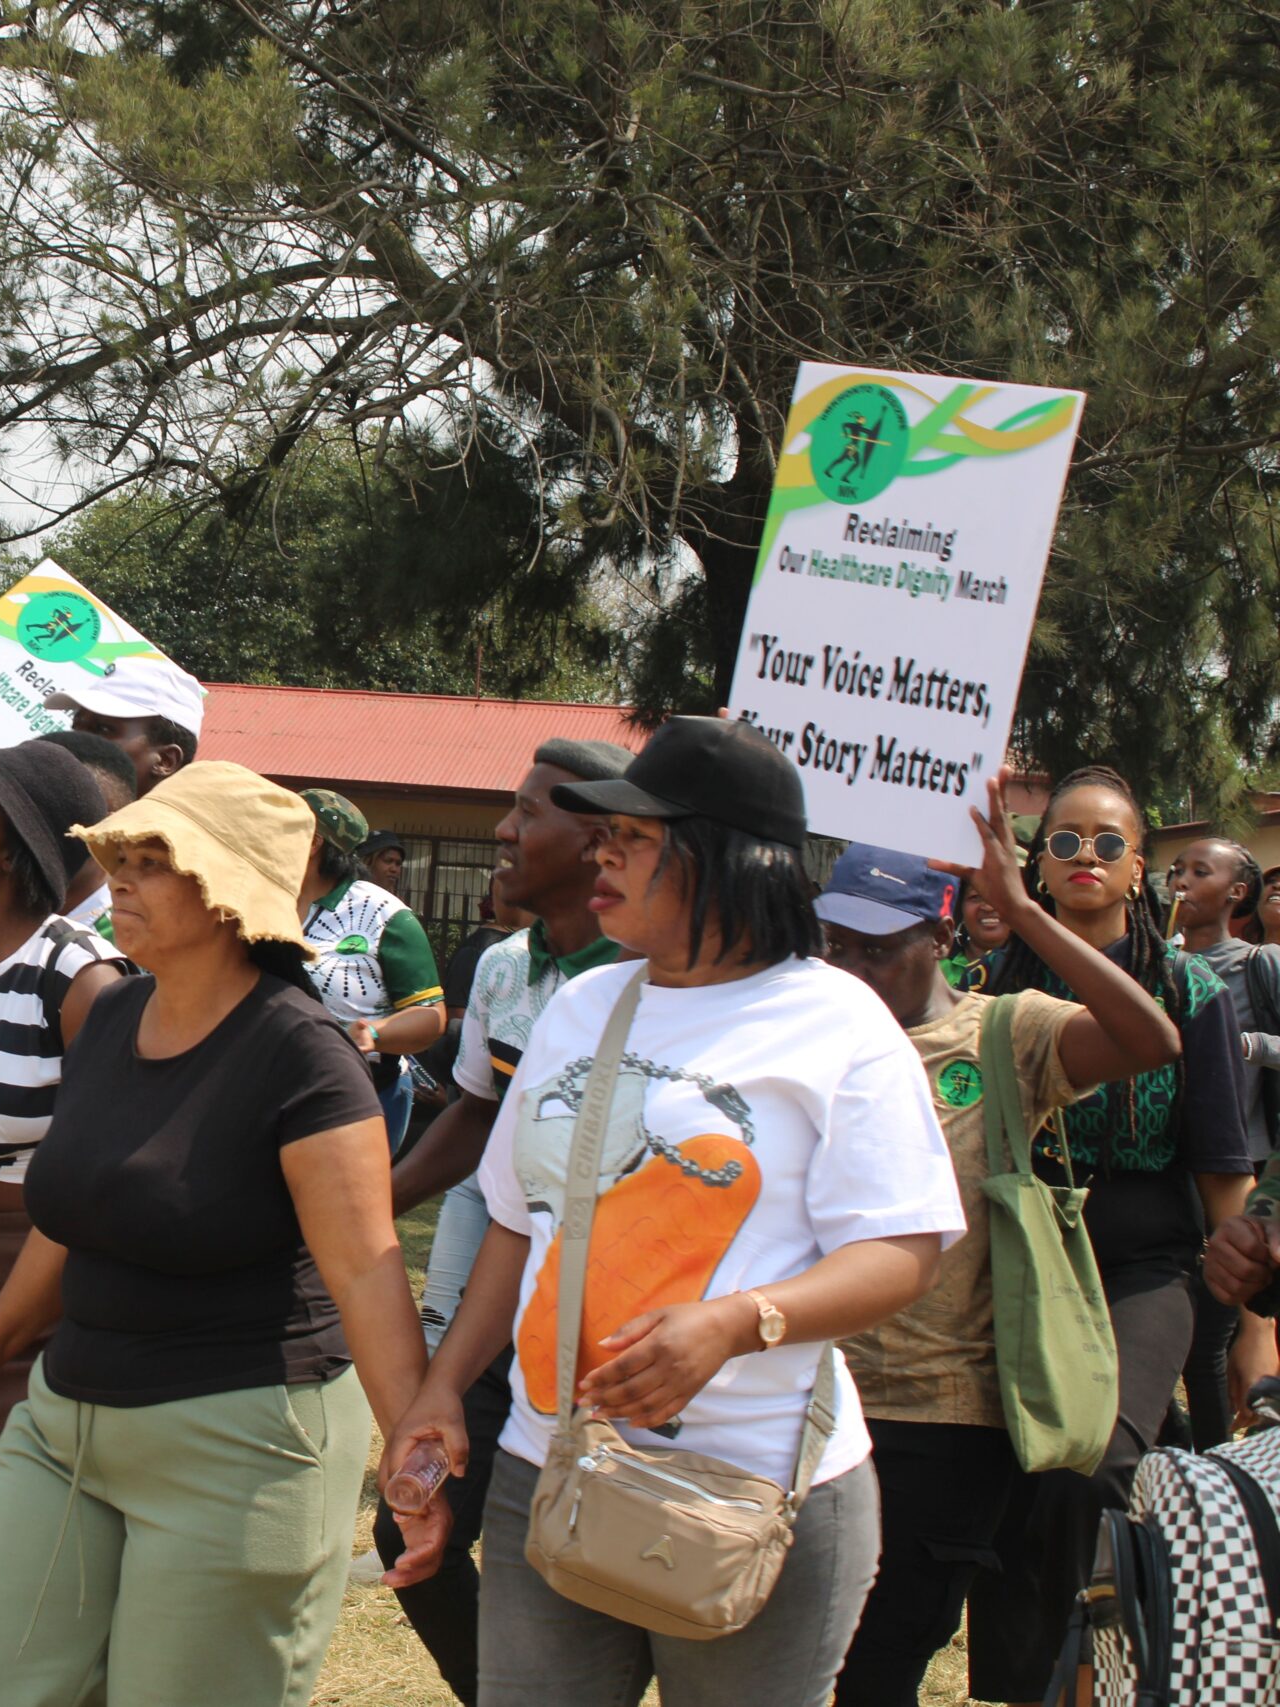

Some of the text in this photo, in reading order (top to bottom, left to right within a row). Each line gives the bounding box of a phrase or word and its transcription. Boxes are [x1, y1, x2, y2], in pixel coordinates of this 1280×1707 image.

[843, 512, 957, 562] Reclaiming
[778, 545, 1008, 605] Our Healthcare Dignity March
[15, 659, 66, 705] Recla
[749, 632, 991, 729] "Your Voice Matters,
[23, 701, 66, 735] Dignit
[797, 722, 868, 786] Story
[869, 734, 983, 797] Matters"
